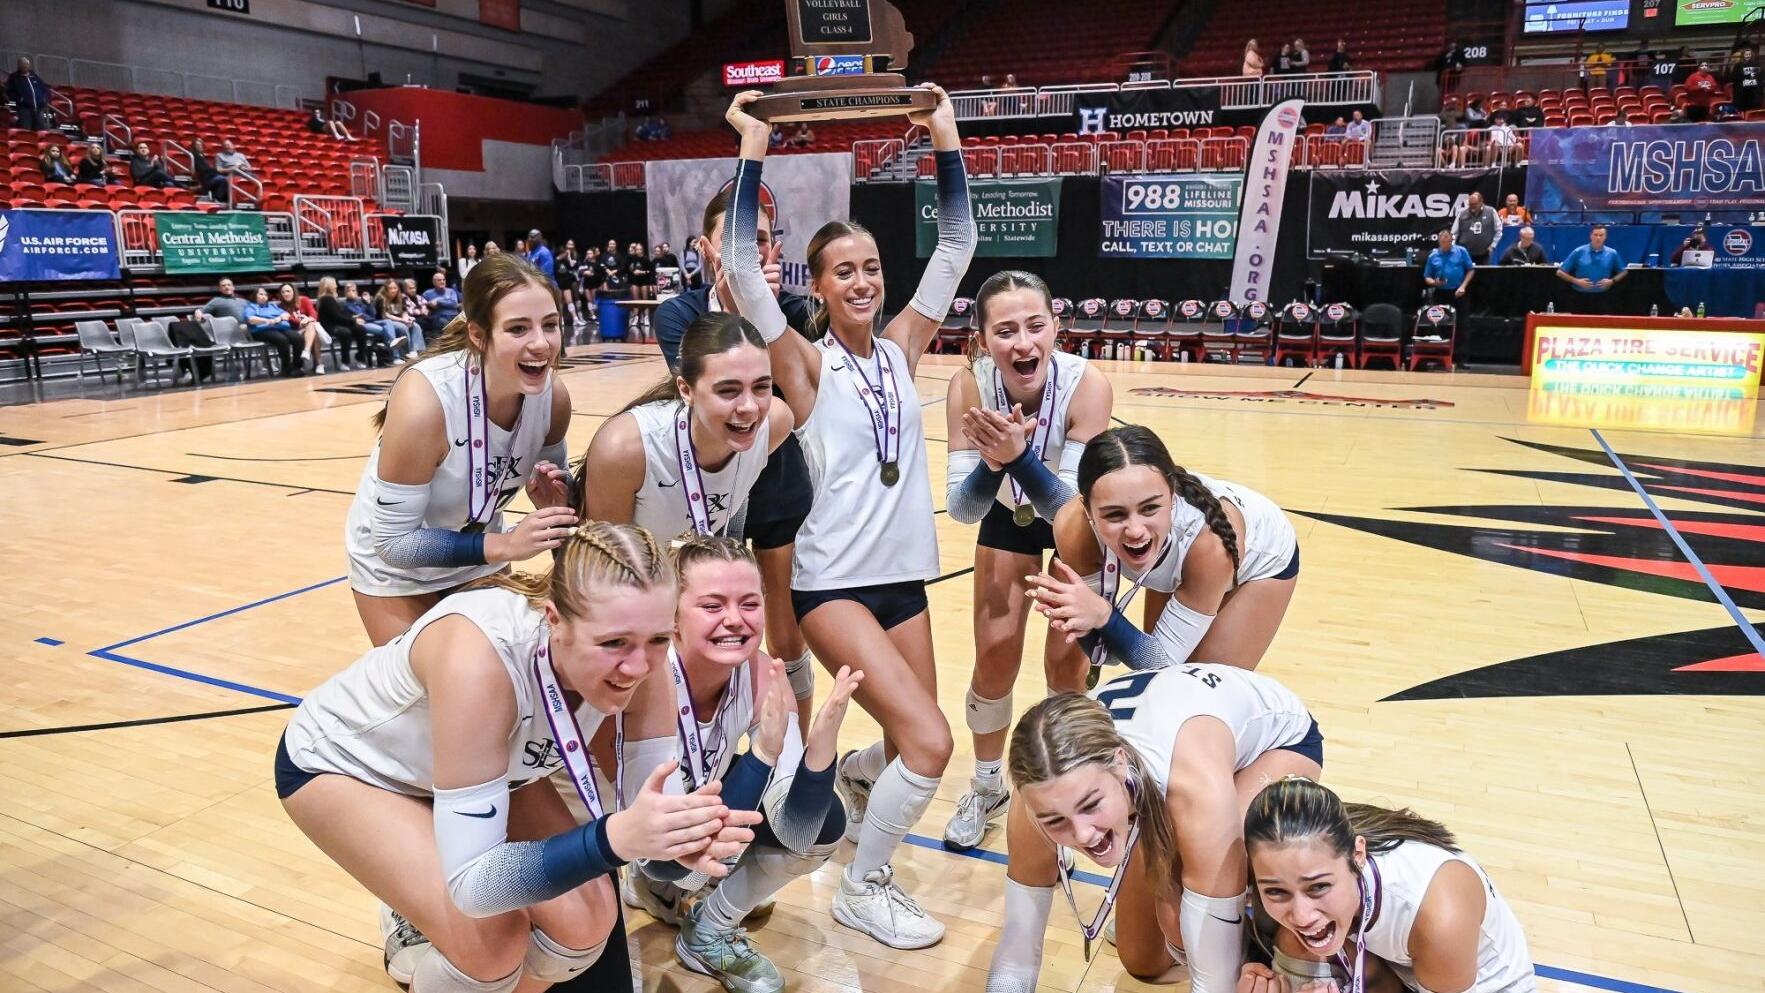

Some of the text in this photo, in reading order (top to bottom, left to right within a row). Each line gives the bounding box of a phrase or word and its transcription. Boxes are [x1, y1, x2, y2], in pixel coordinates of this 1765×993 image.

[805, 0, 861, 8] VOLLEYBALL
[1690, 1, 1726, 9] SERVPRO
[822, 12, 848, 21] GIRLS
[820, 25, 853, 34] CLASS 4
[1463, 46, 1487, 59] 208
[727, 63, 782, 79] Southeast
[1653, 63, 1676, 75] 107
[816, 95, 900, 107] STATE CHAMPIONS
[1109, 110, 1214, 128] HOMETOWN
[1127, 184, 1181, 210] 988
[1185, 190, 1232, 199] LIFELINE
[977, 201, 1054, 218] Methodist
[1184, 200, 1232, 208] MISSOURI
[979, 222, 1038, 232] ERSITY
[1103, 220, 1237, 239] THERE IS HO
[21, 236, 108, 246] U.S. AIR FORCE
[162, 230, 264, 244] Central Methodist
[23, 246, 109, 255] AIRFORCE.COM
[177, 247, 255, 257] UNIVERSITY
[1101, 241, 1231, 254] CALL, TEXT, OR CHAT
[1536, 336, 1761, 374] PLAZA TIRE SERVICE
[1556, 361, 1735, 378] THE QUICK CHANGE ARTIST
[546, 683, 564, 713] MSHSAA
[580, 774, 597, 803] MSHSAA
